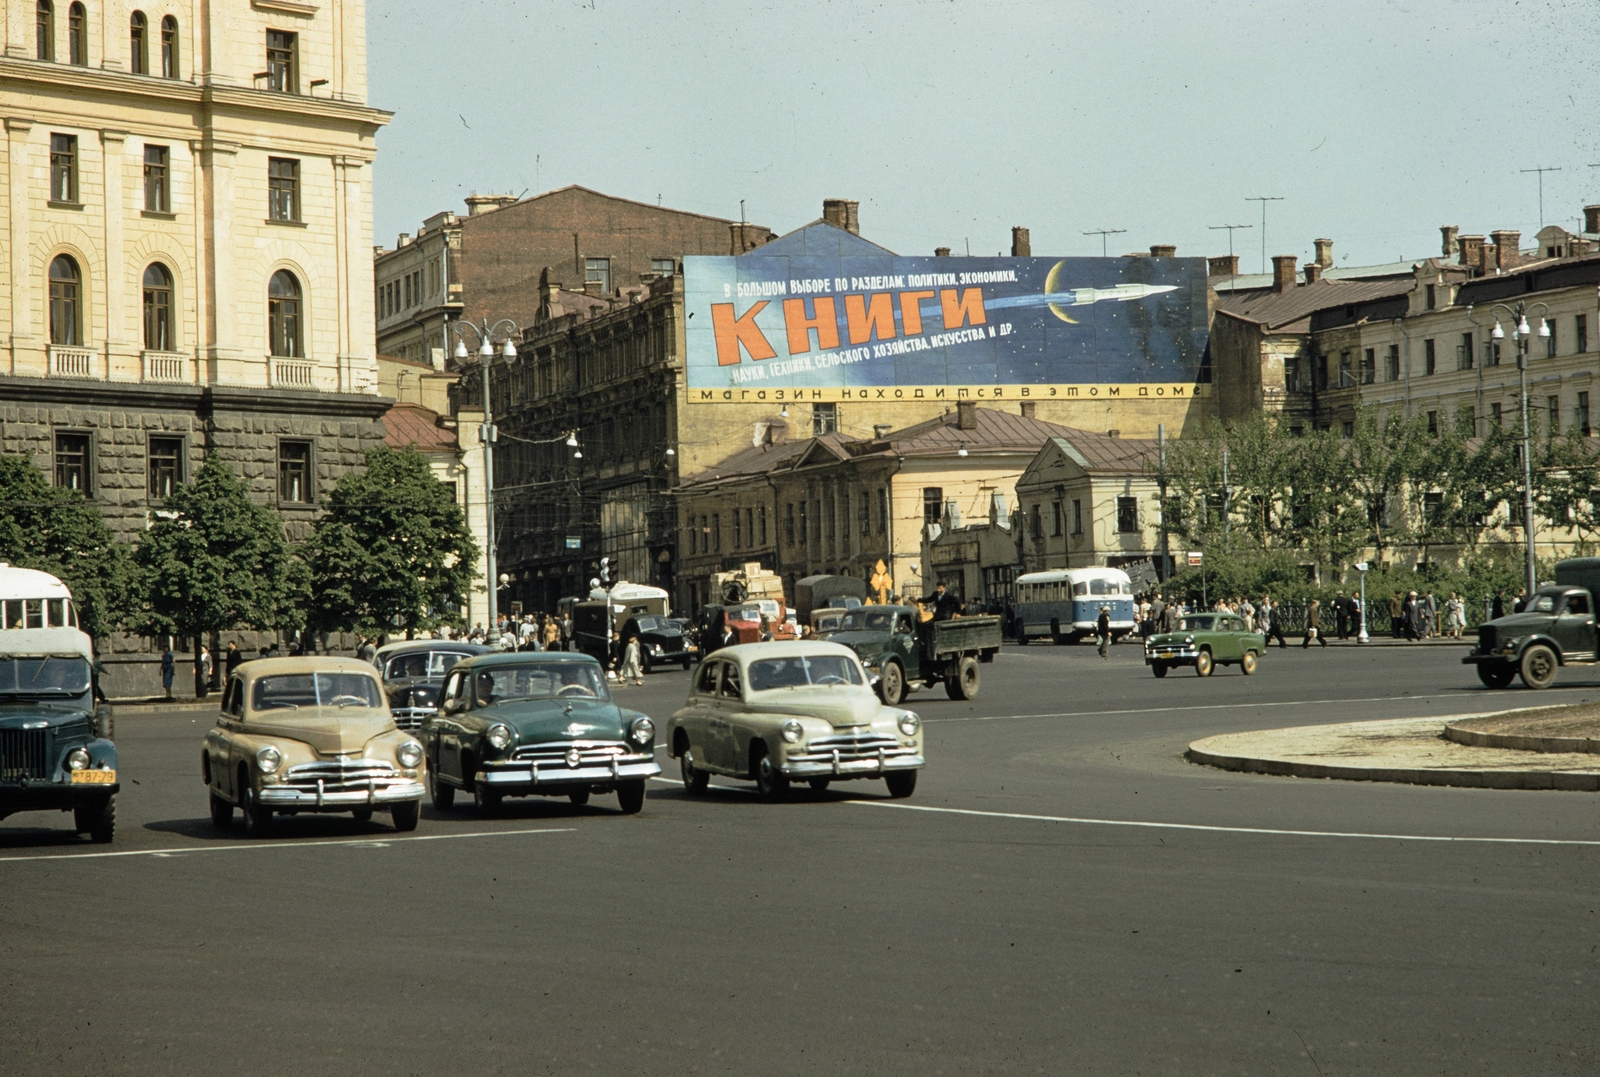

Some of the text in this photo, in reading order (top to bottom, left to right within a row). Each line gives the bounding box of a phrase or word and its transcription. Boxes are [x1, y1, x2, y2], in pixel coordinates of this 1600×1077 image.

[724, 283, 731, 298] В
[737, 281, 786, 297] БОЛЬШОМ
[790, 279, 831, 294] ВЫБОРЕ
[835, 278, 848, 292] ПО
[851, 274, 906, 291] РАЗДЕЛАМ:
[959, 270, 1018, 285] ЭКОНОМИКИ,
[711, 287, 987, 366] КНИГИ
[815, 347, 870, 369] СЕЛЬСКОГО
[930, 327, 986, 348] ИСКУССТВА
[988, 326, 996, 338] И
[1000, 323, 1016, 336] ДР.
[86, 772, 114, 782] 87-79
